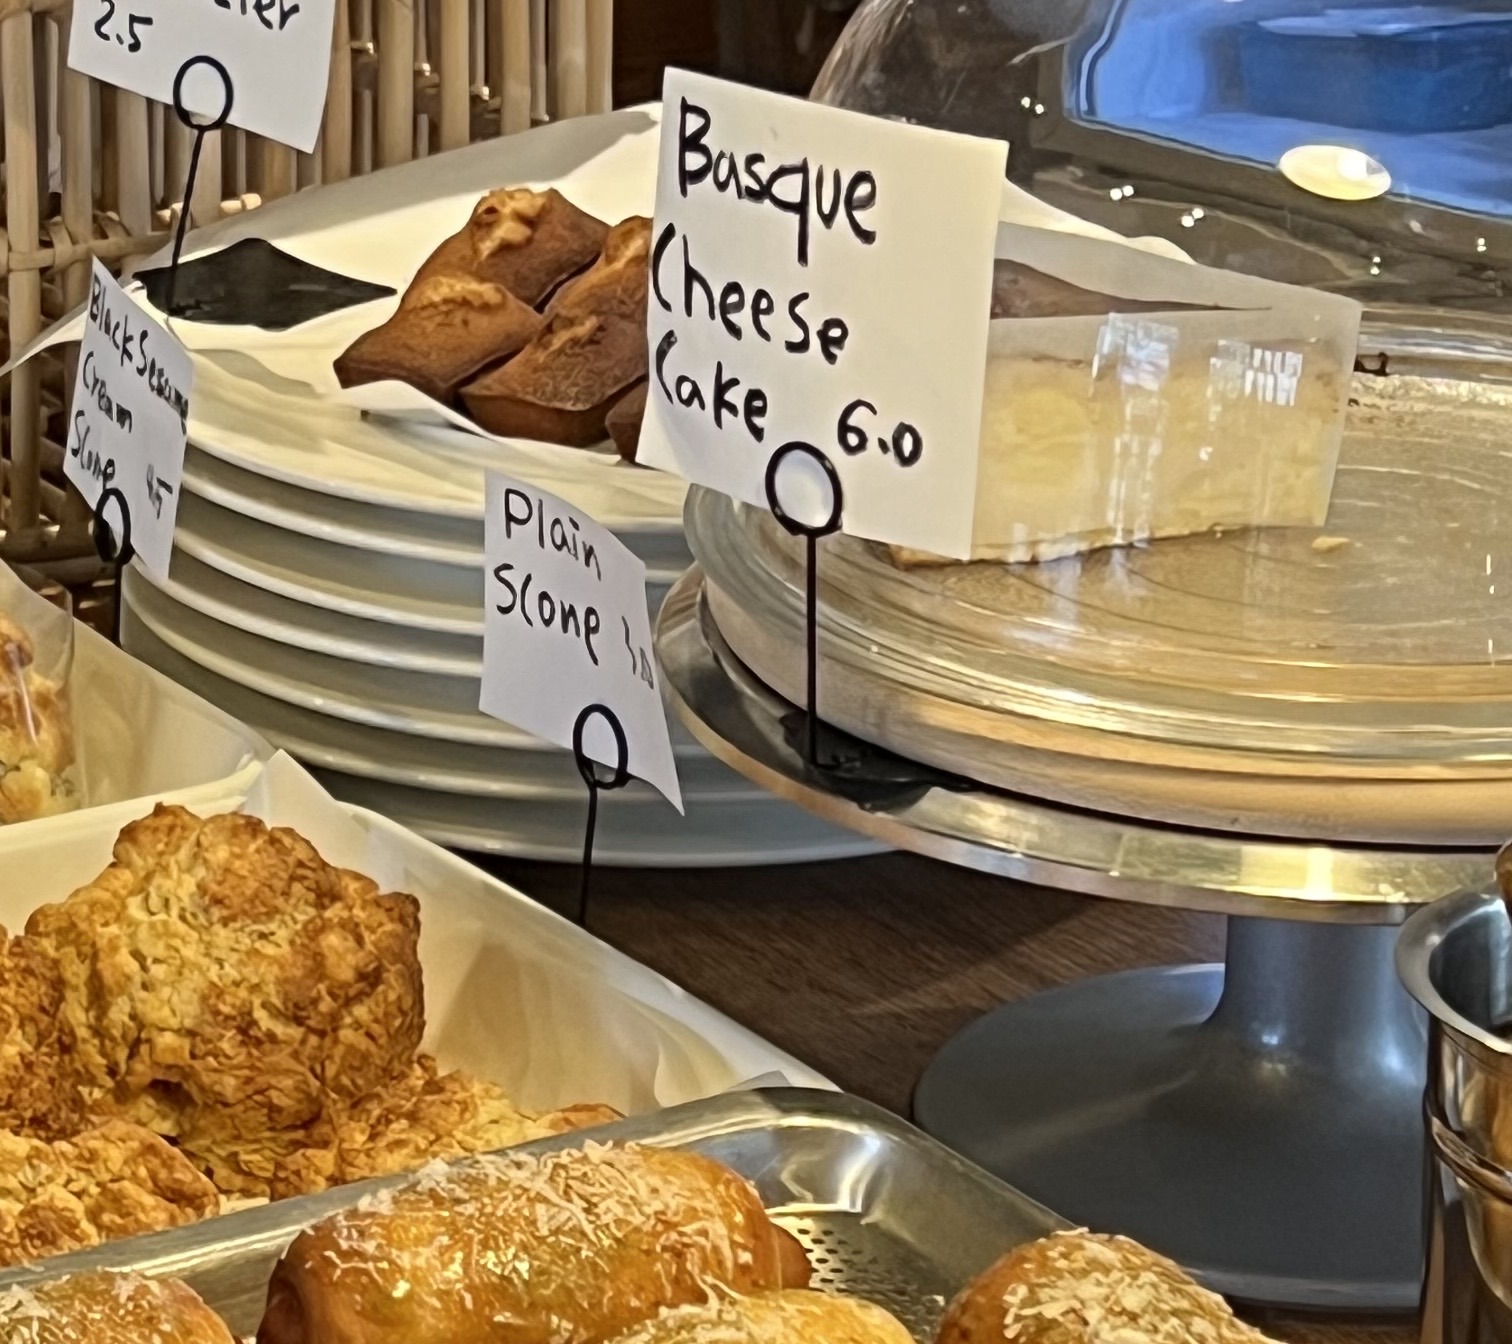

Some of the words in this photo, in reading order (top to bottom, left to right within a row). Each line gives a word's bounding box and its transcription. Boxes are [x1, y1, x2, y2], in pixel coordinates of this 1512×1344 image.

[678, 96, 877, 267] Basque
[89, 273, 134, 367] Black
[652, 222, 849, 365] Cheese
[83, 350, 133, 433] Cream
[655, 330, 768, 443] Cake
[837, 399, 923, 467] 6.0
[71, 409, 116, 490] Scone
[504, 487, 602, 581] Plain
[493, 562, 601, 667] Scone
